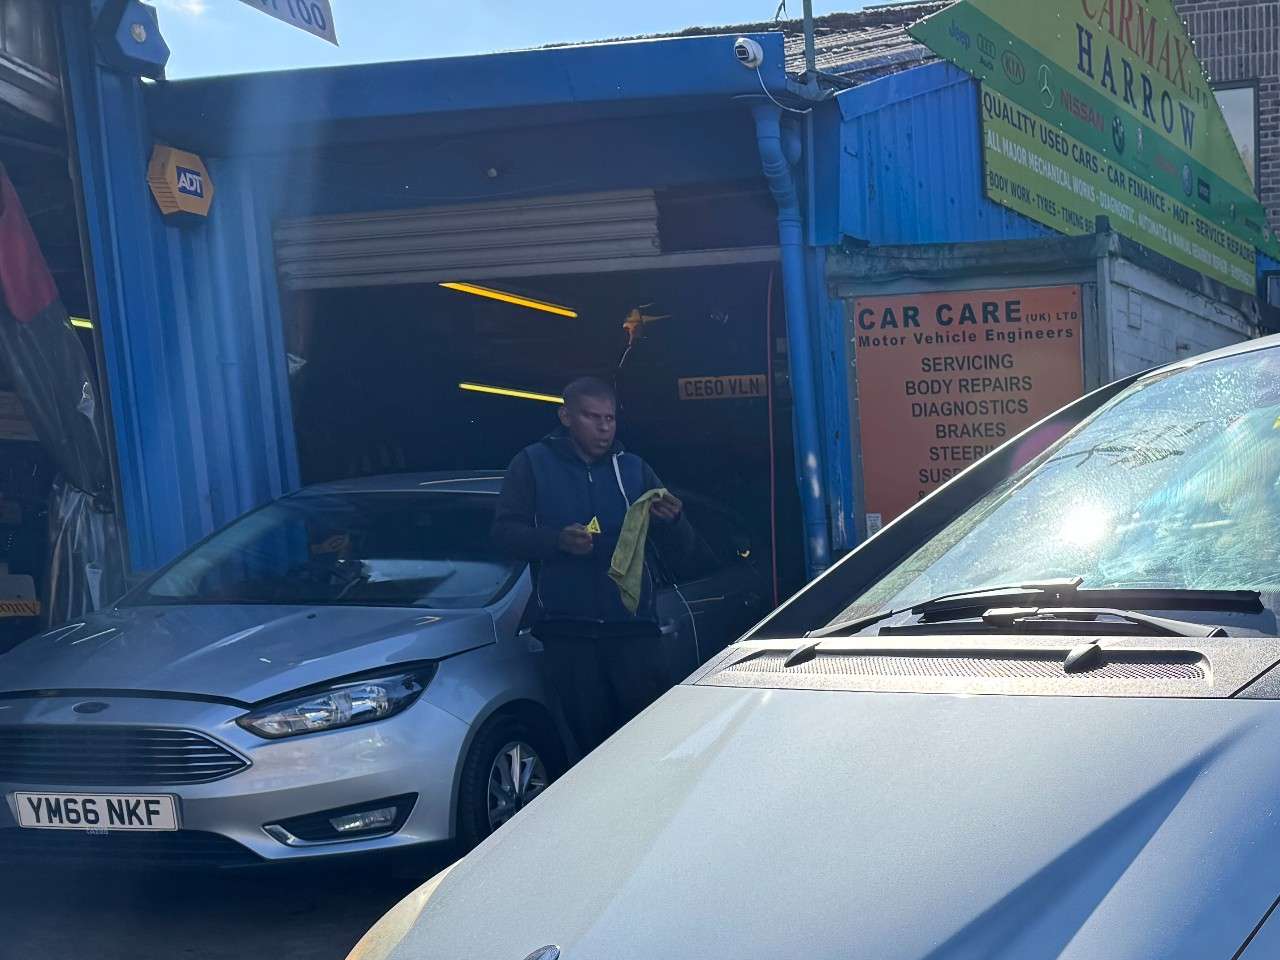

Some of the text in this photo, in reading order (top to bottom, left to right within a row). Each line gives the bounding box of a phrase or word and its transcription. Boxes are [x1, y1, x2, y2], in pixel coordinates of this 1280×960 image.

[1075, 22, 1196, 151] HARROW
[1060, 87, 1105, 133] NISSAN
[987, 128, 1001, 153] ALL
[1002, 136, 1028, 169] MAJOR
[178, 172, 203, 193] ADT
[983, 91, 1036, 138] QUALITY
[1040, 123, 1070, 156] USED
[1072, 143, 1099, 174] CARS
[1107, 165, 1126, 191] CAR
[1128, 175, 1166, 213] FINANCE
[1196, 217, 1226, 249] SERVICE
[989, 170, 1009, 194] BODY
[1010, 182, 1031, 203] WORK
[1036, 193, 1057, 217] TYRES
[858, 300, 1078, 331] CAR CARE (UK) LTD
[858, 326, 1074, 348] Motor Vehicle Engineers
[921, 353, 1014, 373] SERVICING
[684, 377, 760, 398] CE60 VLN
[905, 375, 1033, 397] BODY REPAIRS
[911, 398, 1029, 418] DIAGNOSTICS
[935, 422, 1007, 440] BRAKES
[27, 797, 161, 826] YM66 NKF
